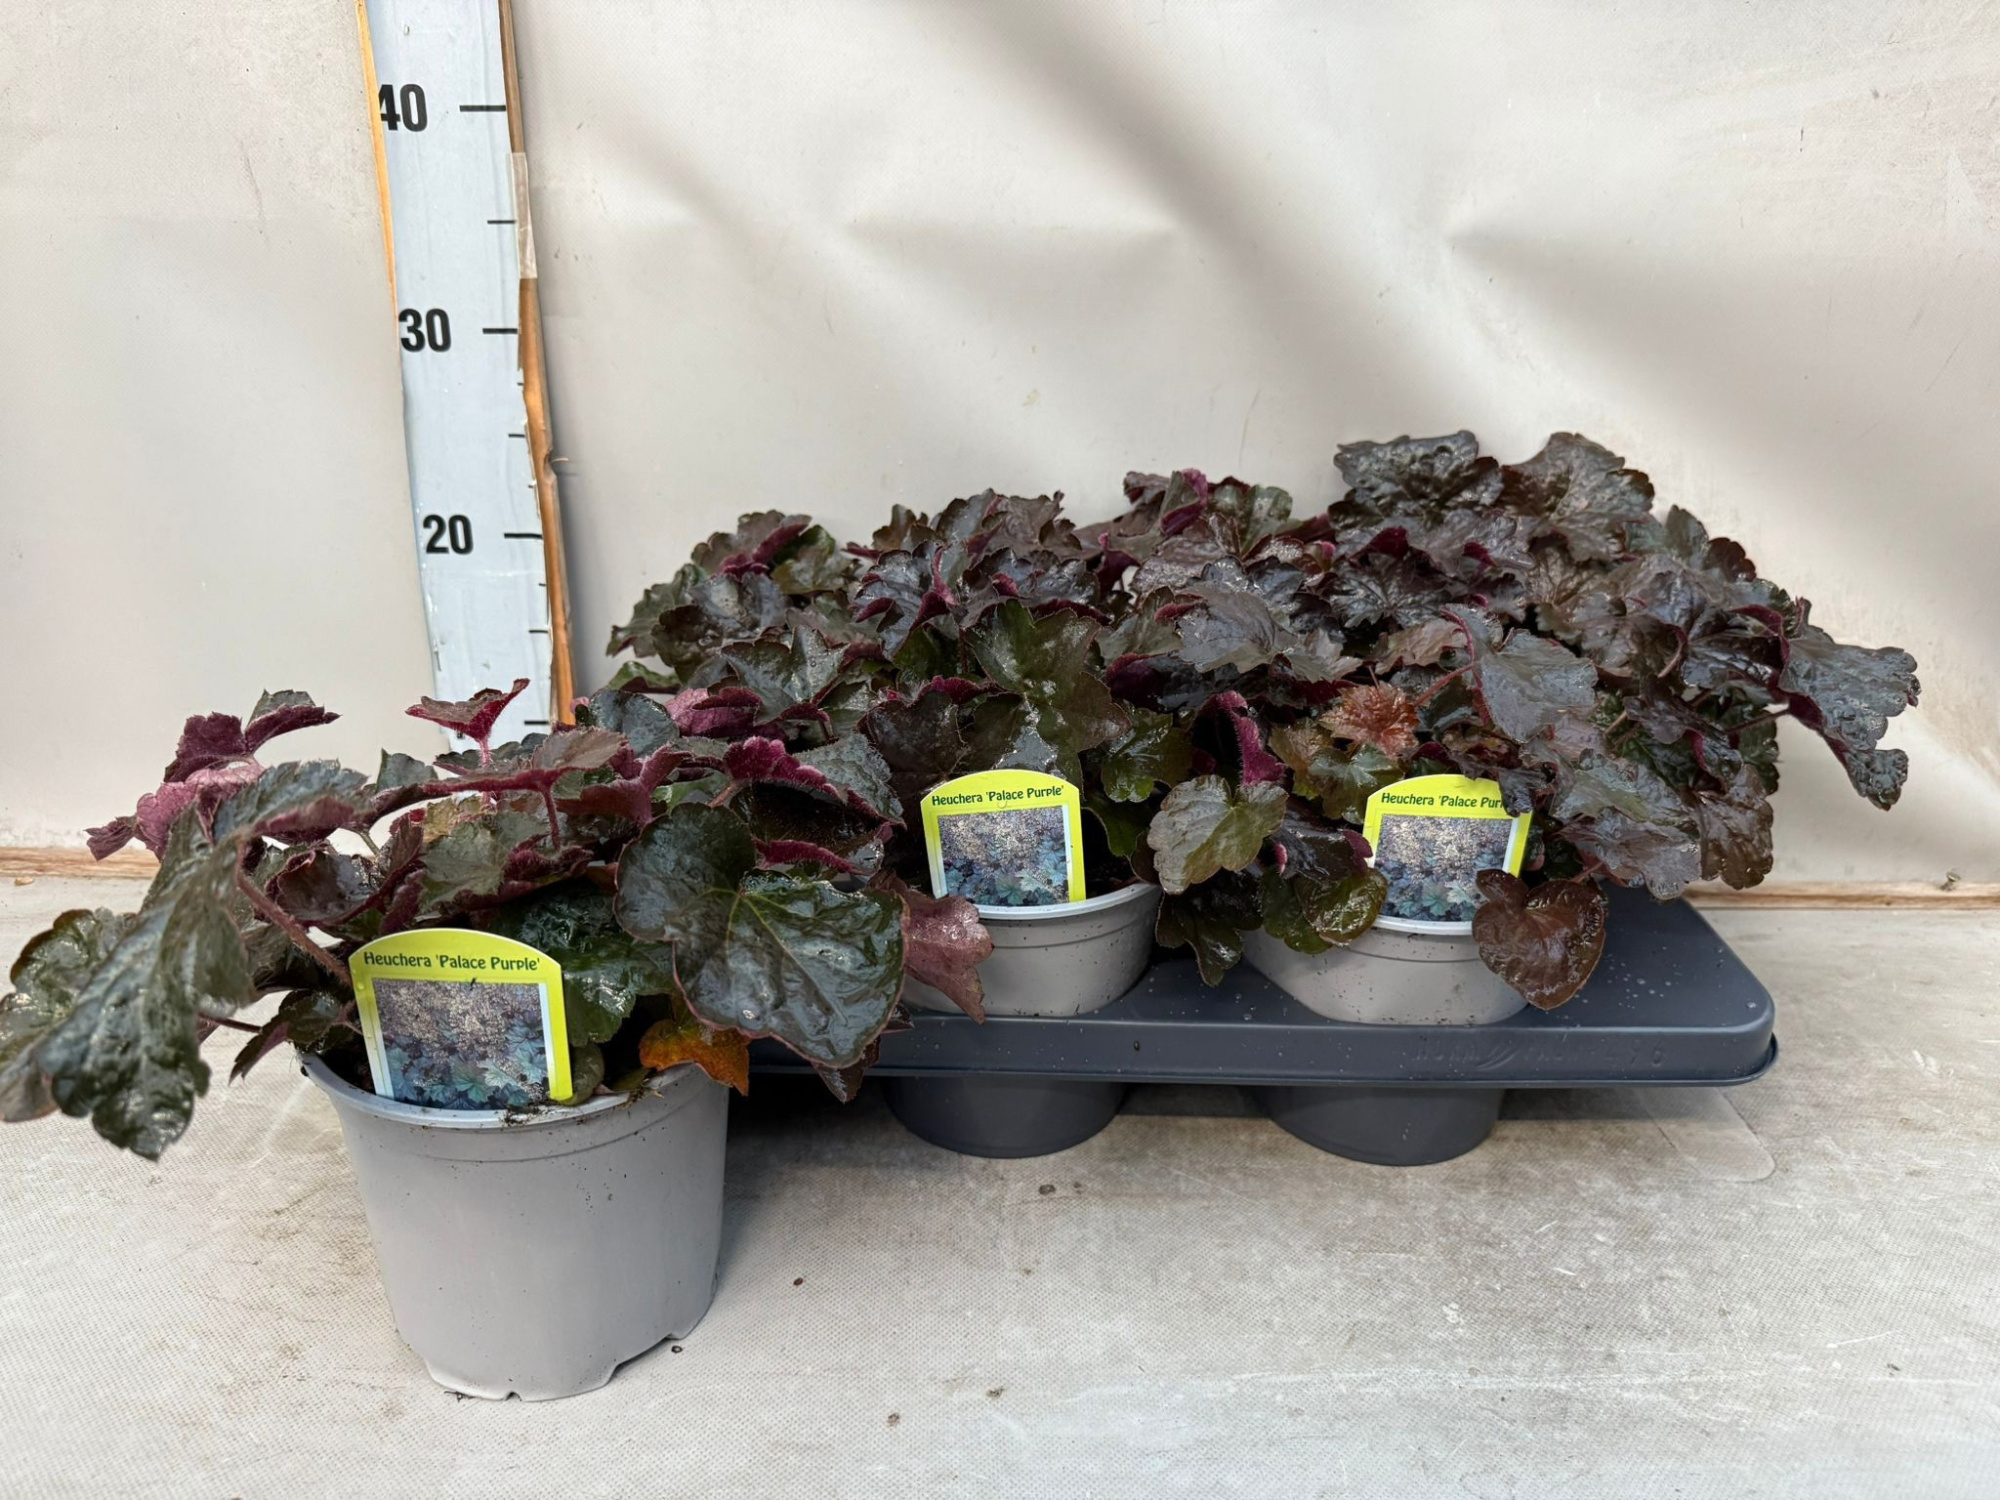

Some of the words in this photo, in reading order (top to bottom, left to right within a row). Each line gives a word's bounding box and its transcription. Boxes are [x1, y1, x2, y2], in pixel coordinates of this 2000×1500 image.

[377, 82, 428, 132] 40
[398, 306, 453, 353] 30
[422, 513, 474, 555] 20
[932, 794, 983, 806] Heuchera
[986, 790, 1024, 801] 'Palace
[1027, 785, 1064, 798] Purple'
[1381, 793, 1434, 805] Heuchera
[1438, 795, 1477, 807] 'Palace
[364, 952, 432, 967] Heuchera
[435, 954, 487, 969] 'Palace
[491, 956, 541, 970] Purple'
